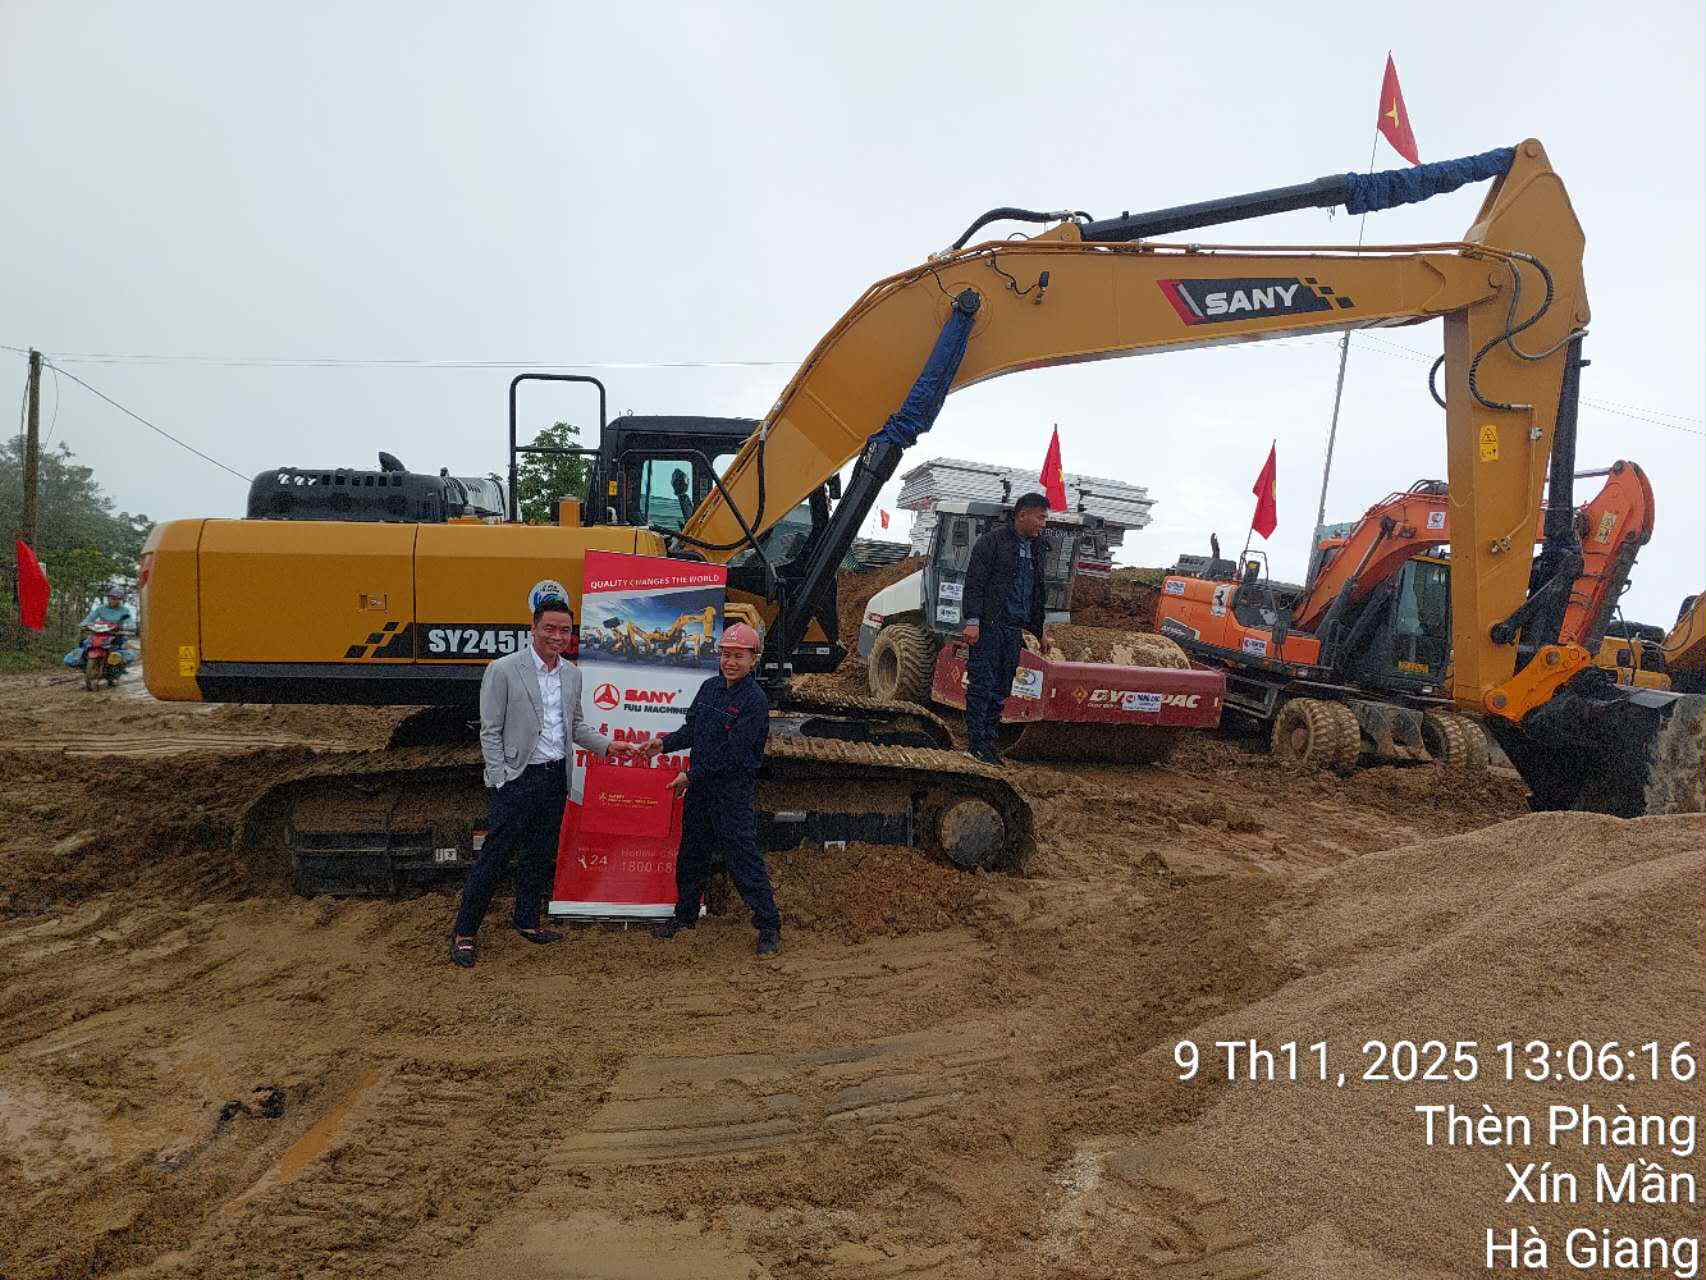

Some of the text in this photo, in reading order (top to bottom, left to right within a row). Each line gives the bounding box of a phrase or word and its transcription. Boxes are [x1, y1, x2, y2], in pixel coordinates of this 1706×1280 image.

[1204, 283, 1299, 316] SANY
[591, 574, 720, 590] QUALITY CHANGES THE WORLD
[428, 629, 532, 654] SY245H
[624, 688, 676, 704] SANY
